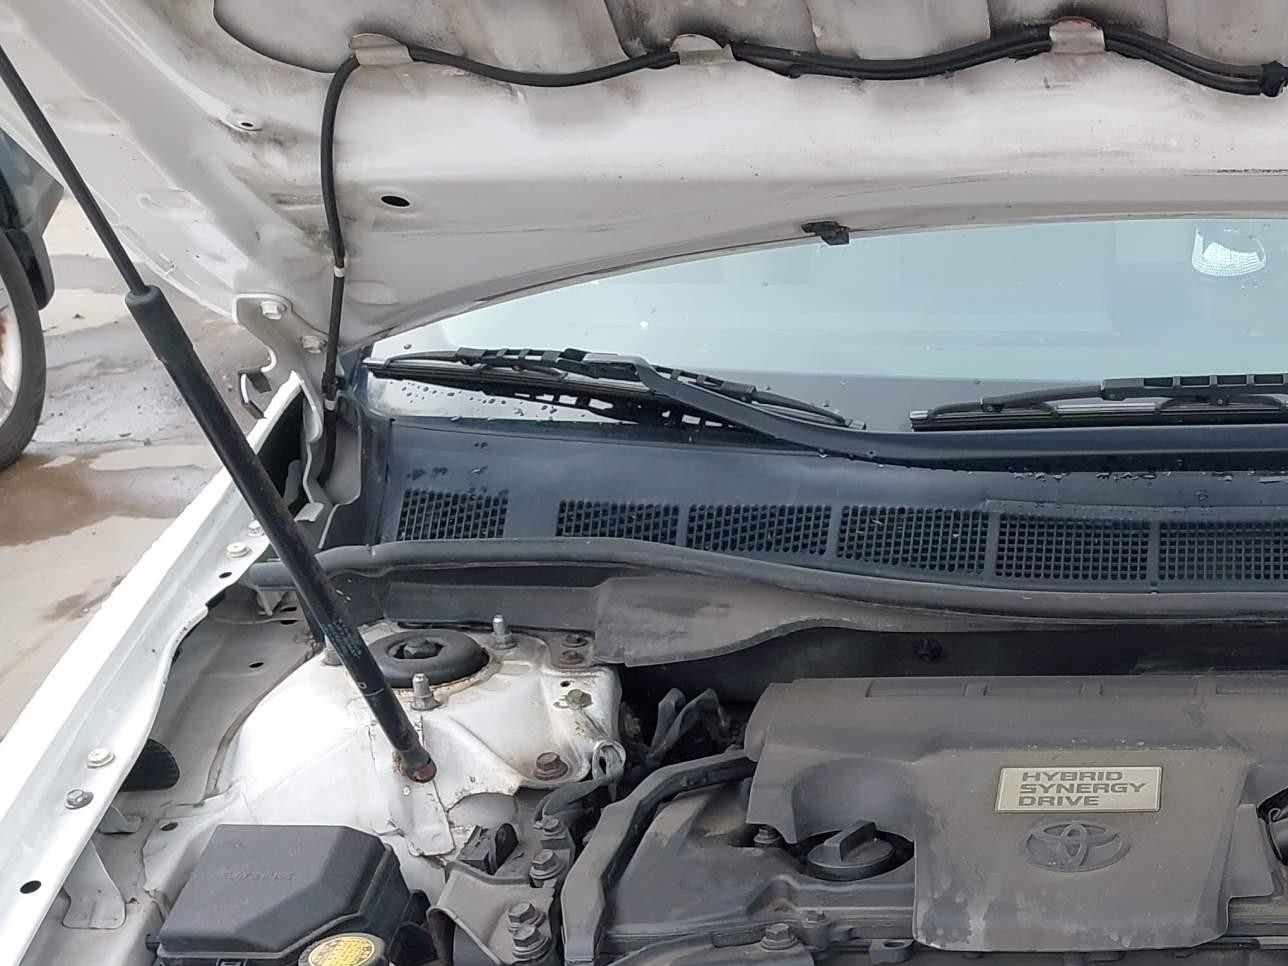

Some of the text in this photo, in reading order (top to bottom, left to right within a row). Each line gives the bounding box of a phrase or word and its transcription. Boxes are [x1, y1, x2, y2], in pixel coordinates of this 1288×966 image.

[1022, 771, 1123, 781] HYBRID
[1019, 783, 1147, 794] SYNERGY
[1018, 796, 1100, 807] DRIVE
